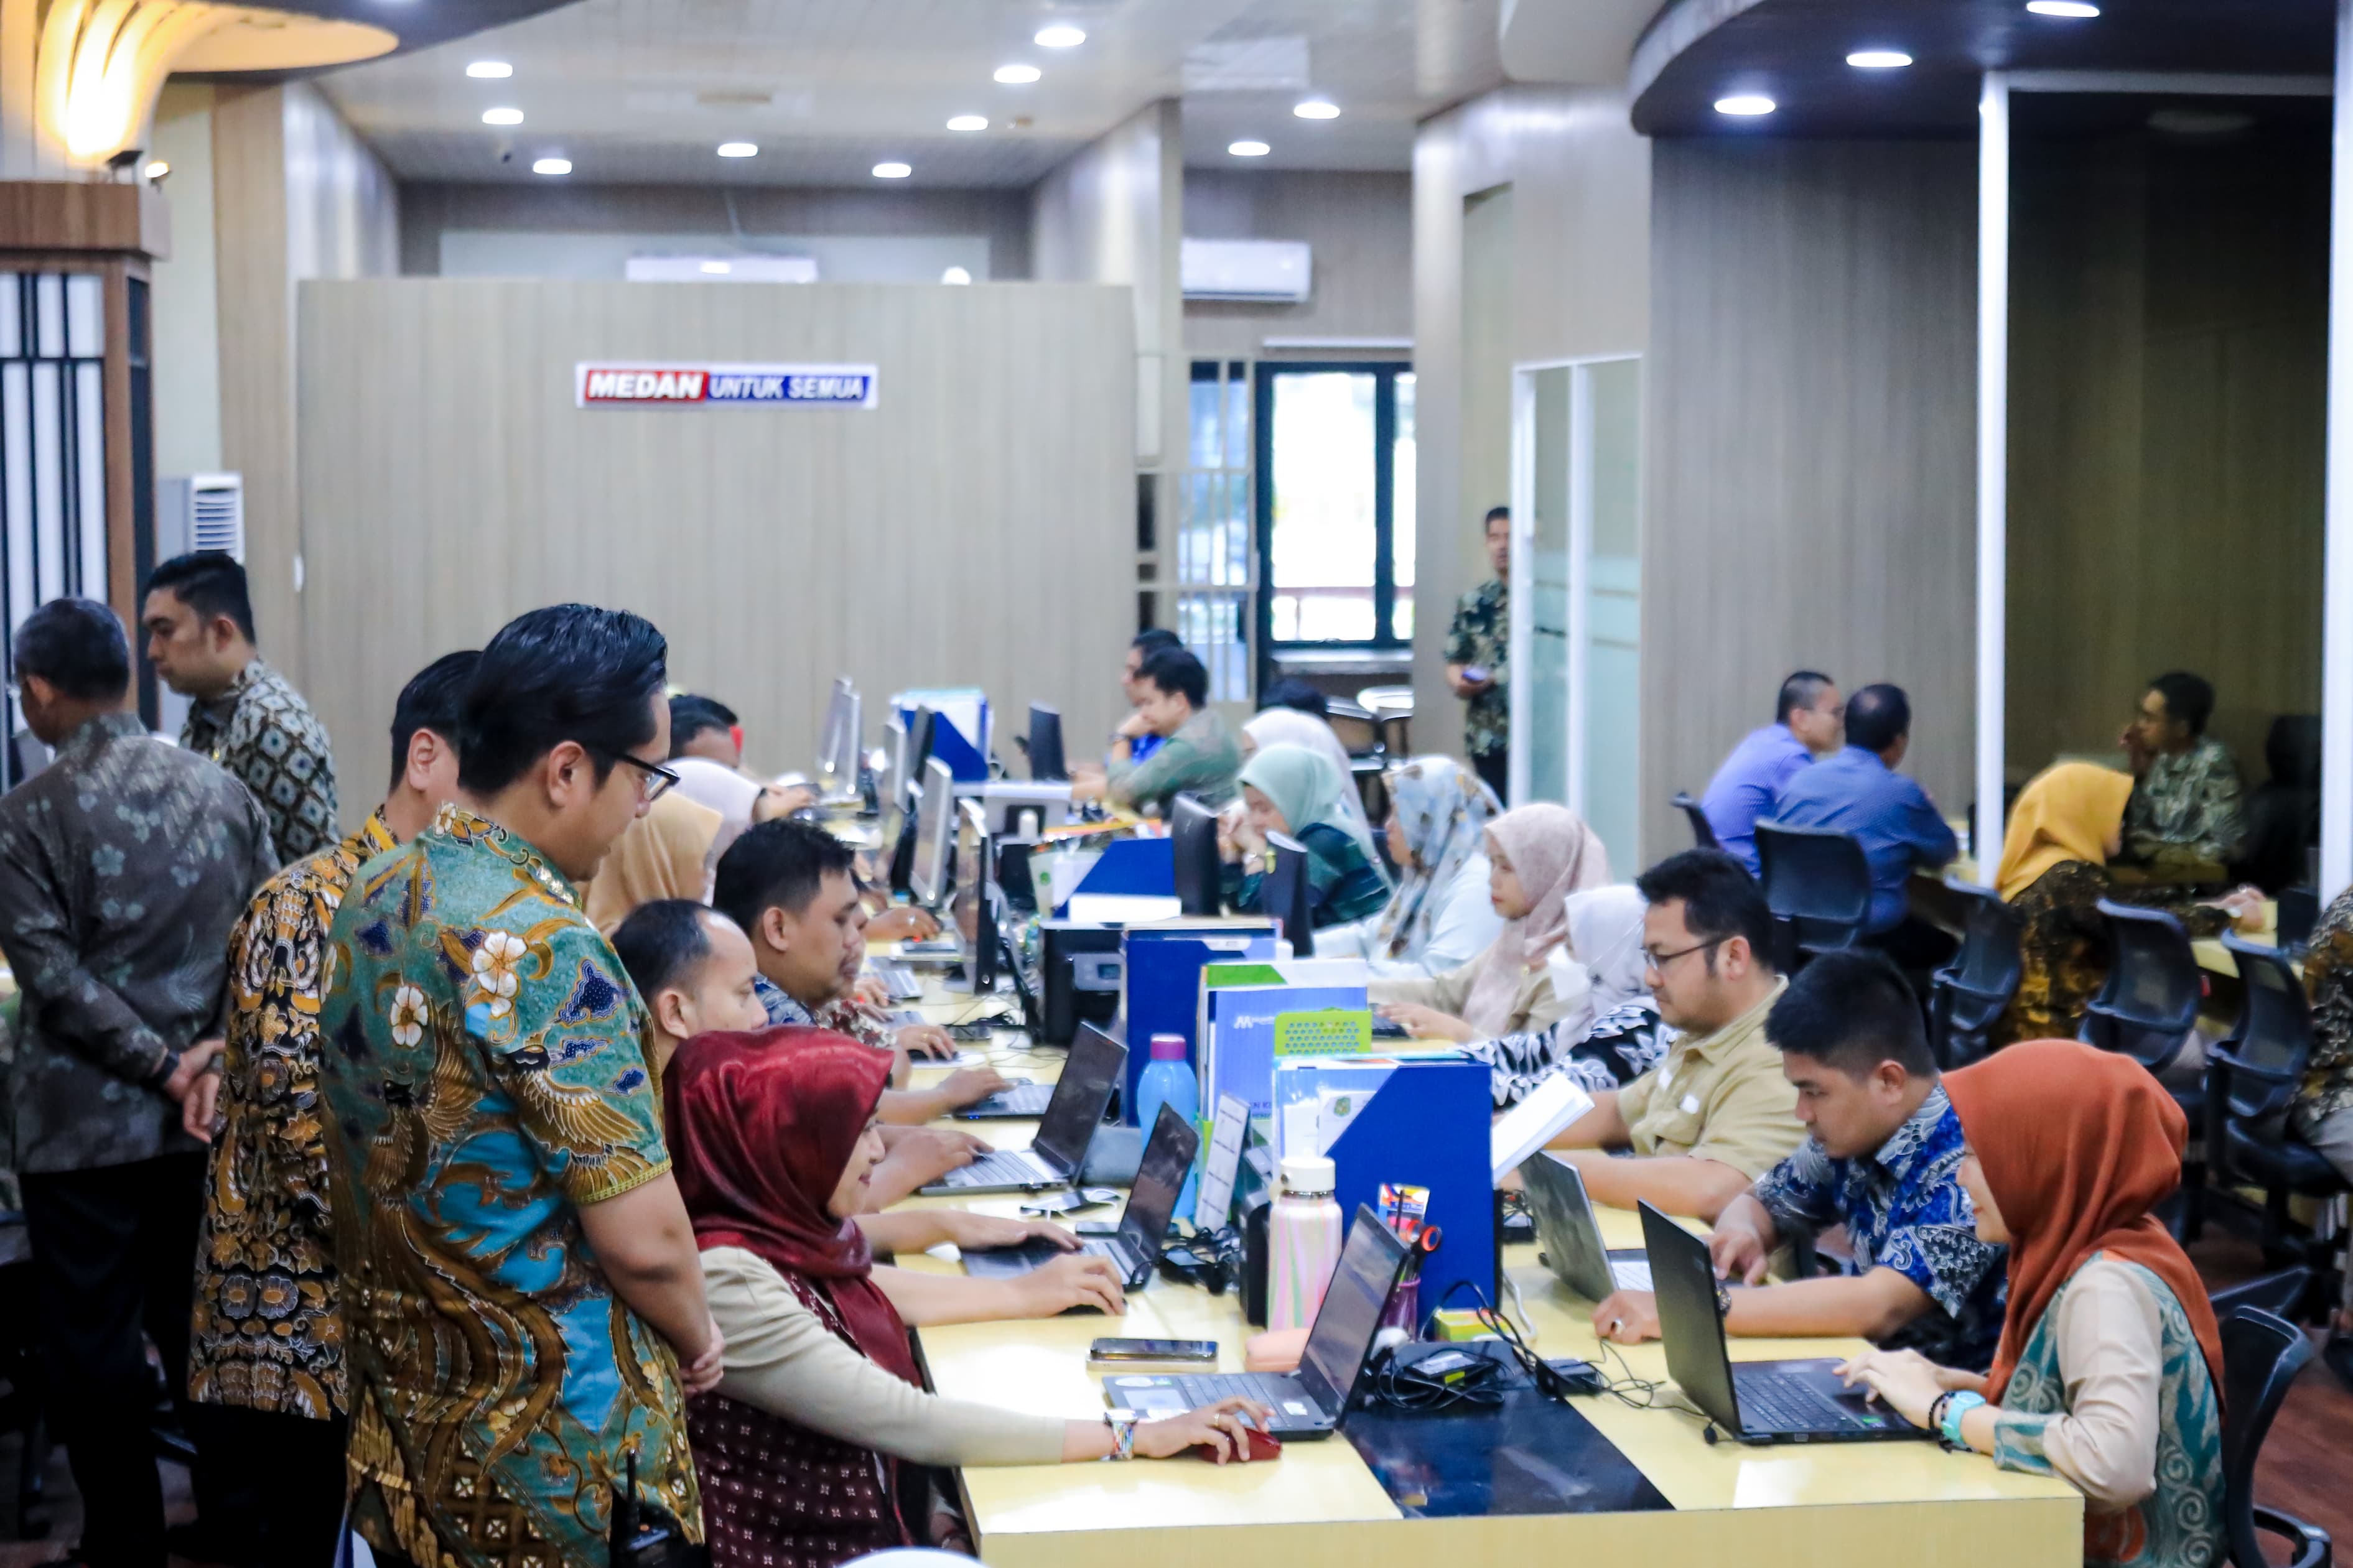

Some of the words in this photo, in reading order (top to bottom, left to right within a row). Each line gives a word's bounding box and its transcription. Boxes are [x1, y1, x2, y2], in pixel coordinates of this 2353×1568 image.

[588, 373, 704, 398] MEDAN
[708, 376, 784, 399] UNTUK
[787, 377, 864, 399] SEMUA
